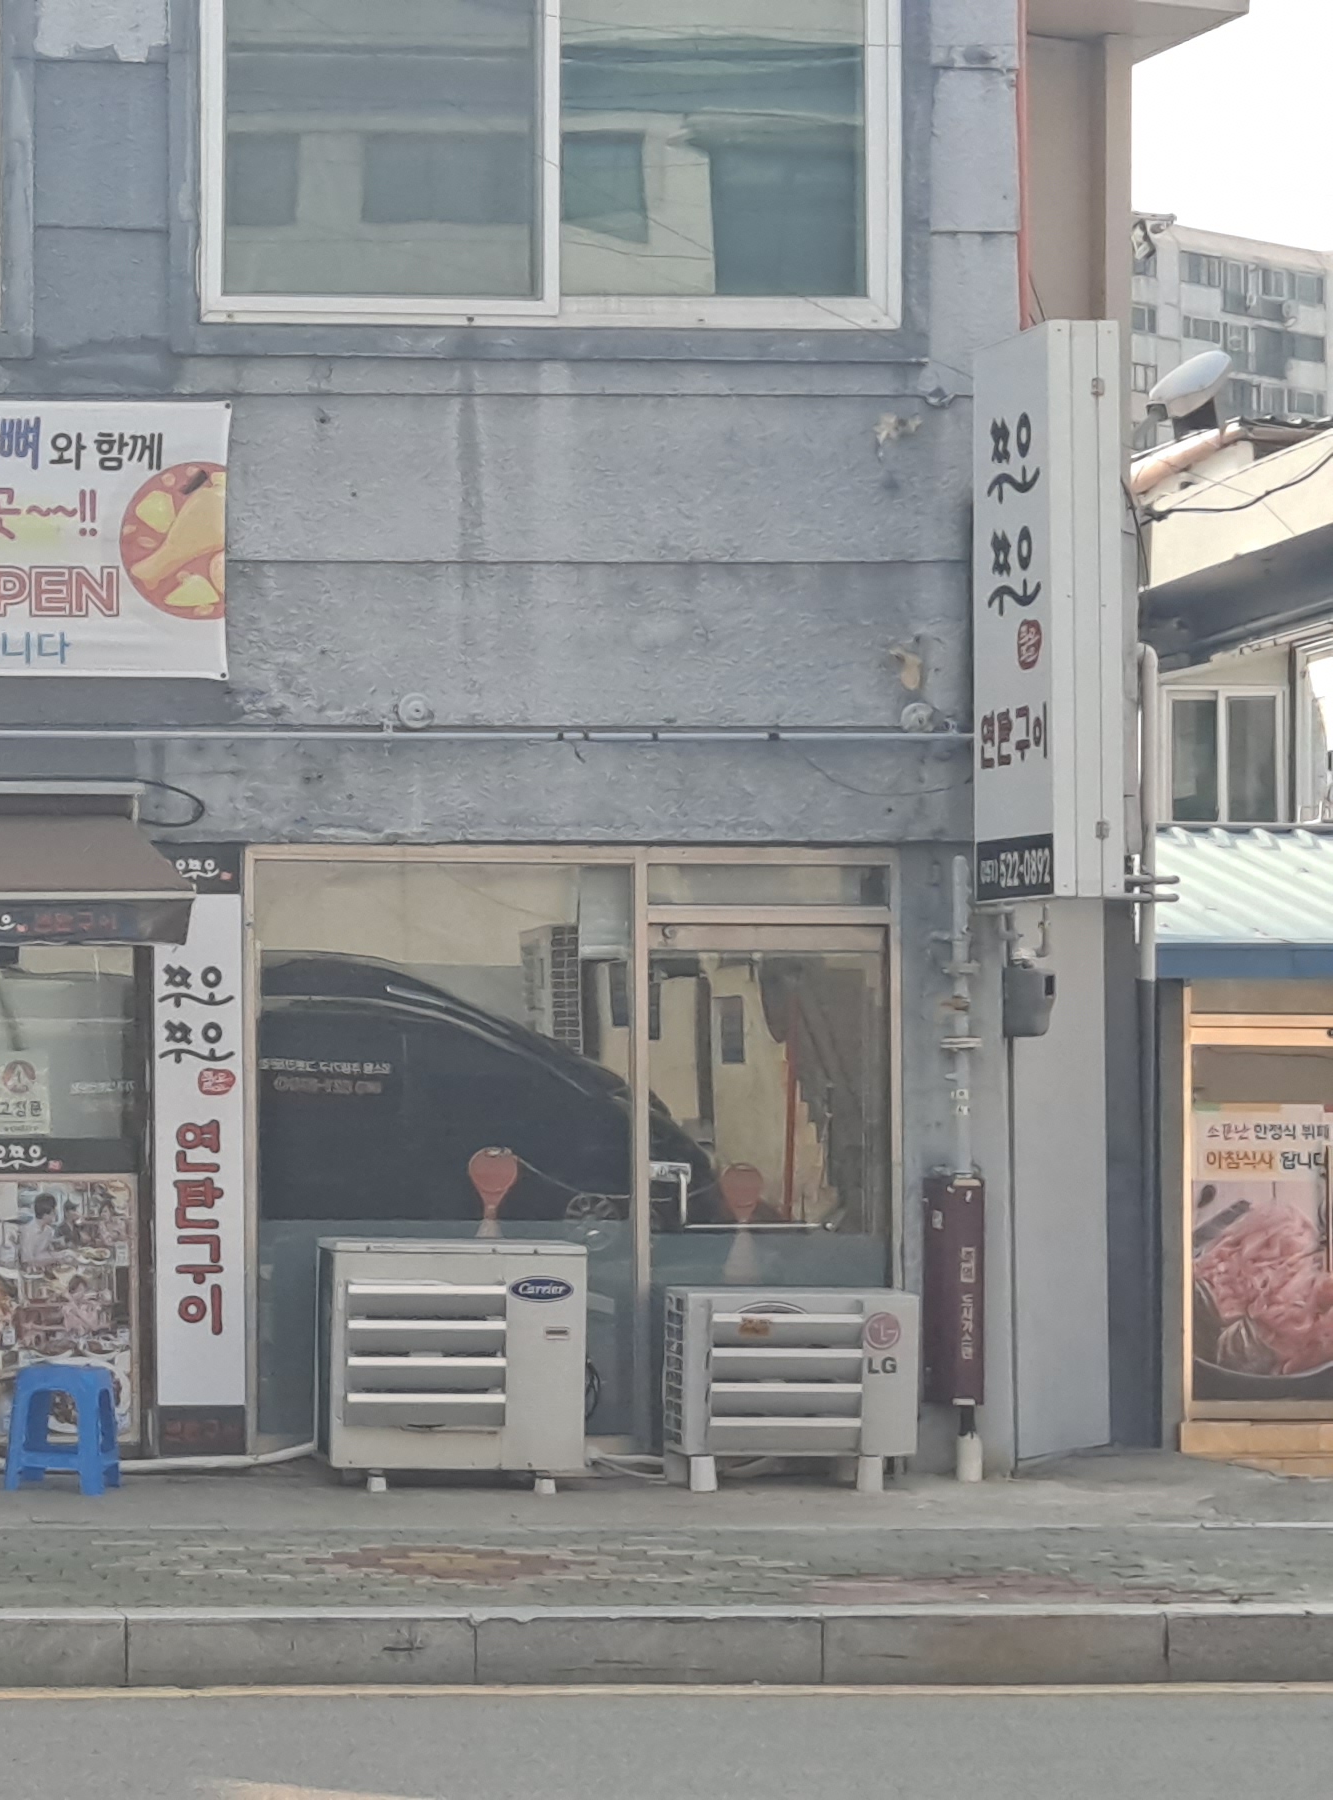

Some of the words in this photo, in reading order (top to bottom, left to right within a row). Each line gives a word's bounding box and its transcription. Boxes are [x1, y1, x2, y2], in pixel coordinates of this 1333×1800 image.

[49, 432, 86, 471] 와
[94, 432, 163, 471] 함께
[980, 701, 1048, 770] 연탄구이
[175, 858, 220, 880] 오쭈오
[1000, 847, 1051, 889] 522-0892
[1253, 1122, 1296, 1141] 한정식
[1206, 1150, 1274, 1169] 아침식사
[173, 1119, 224, 1336] 연탄구이
[518, 1281, 568, 1297] Carrier
[866, 1356, 897, 1375] LG
